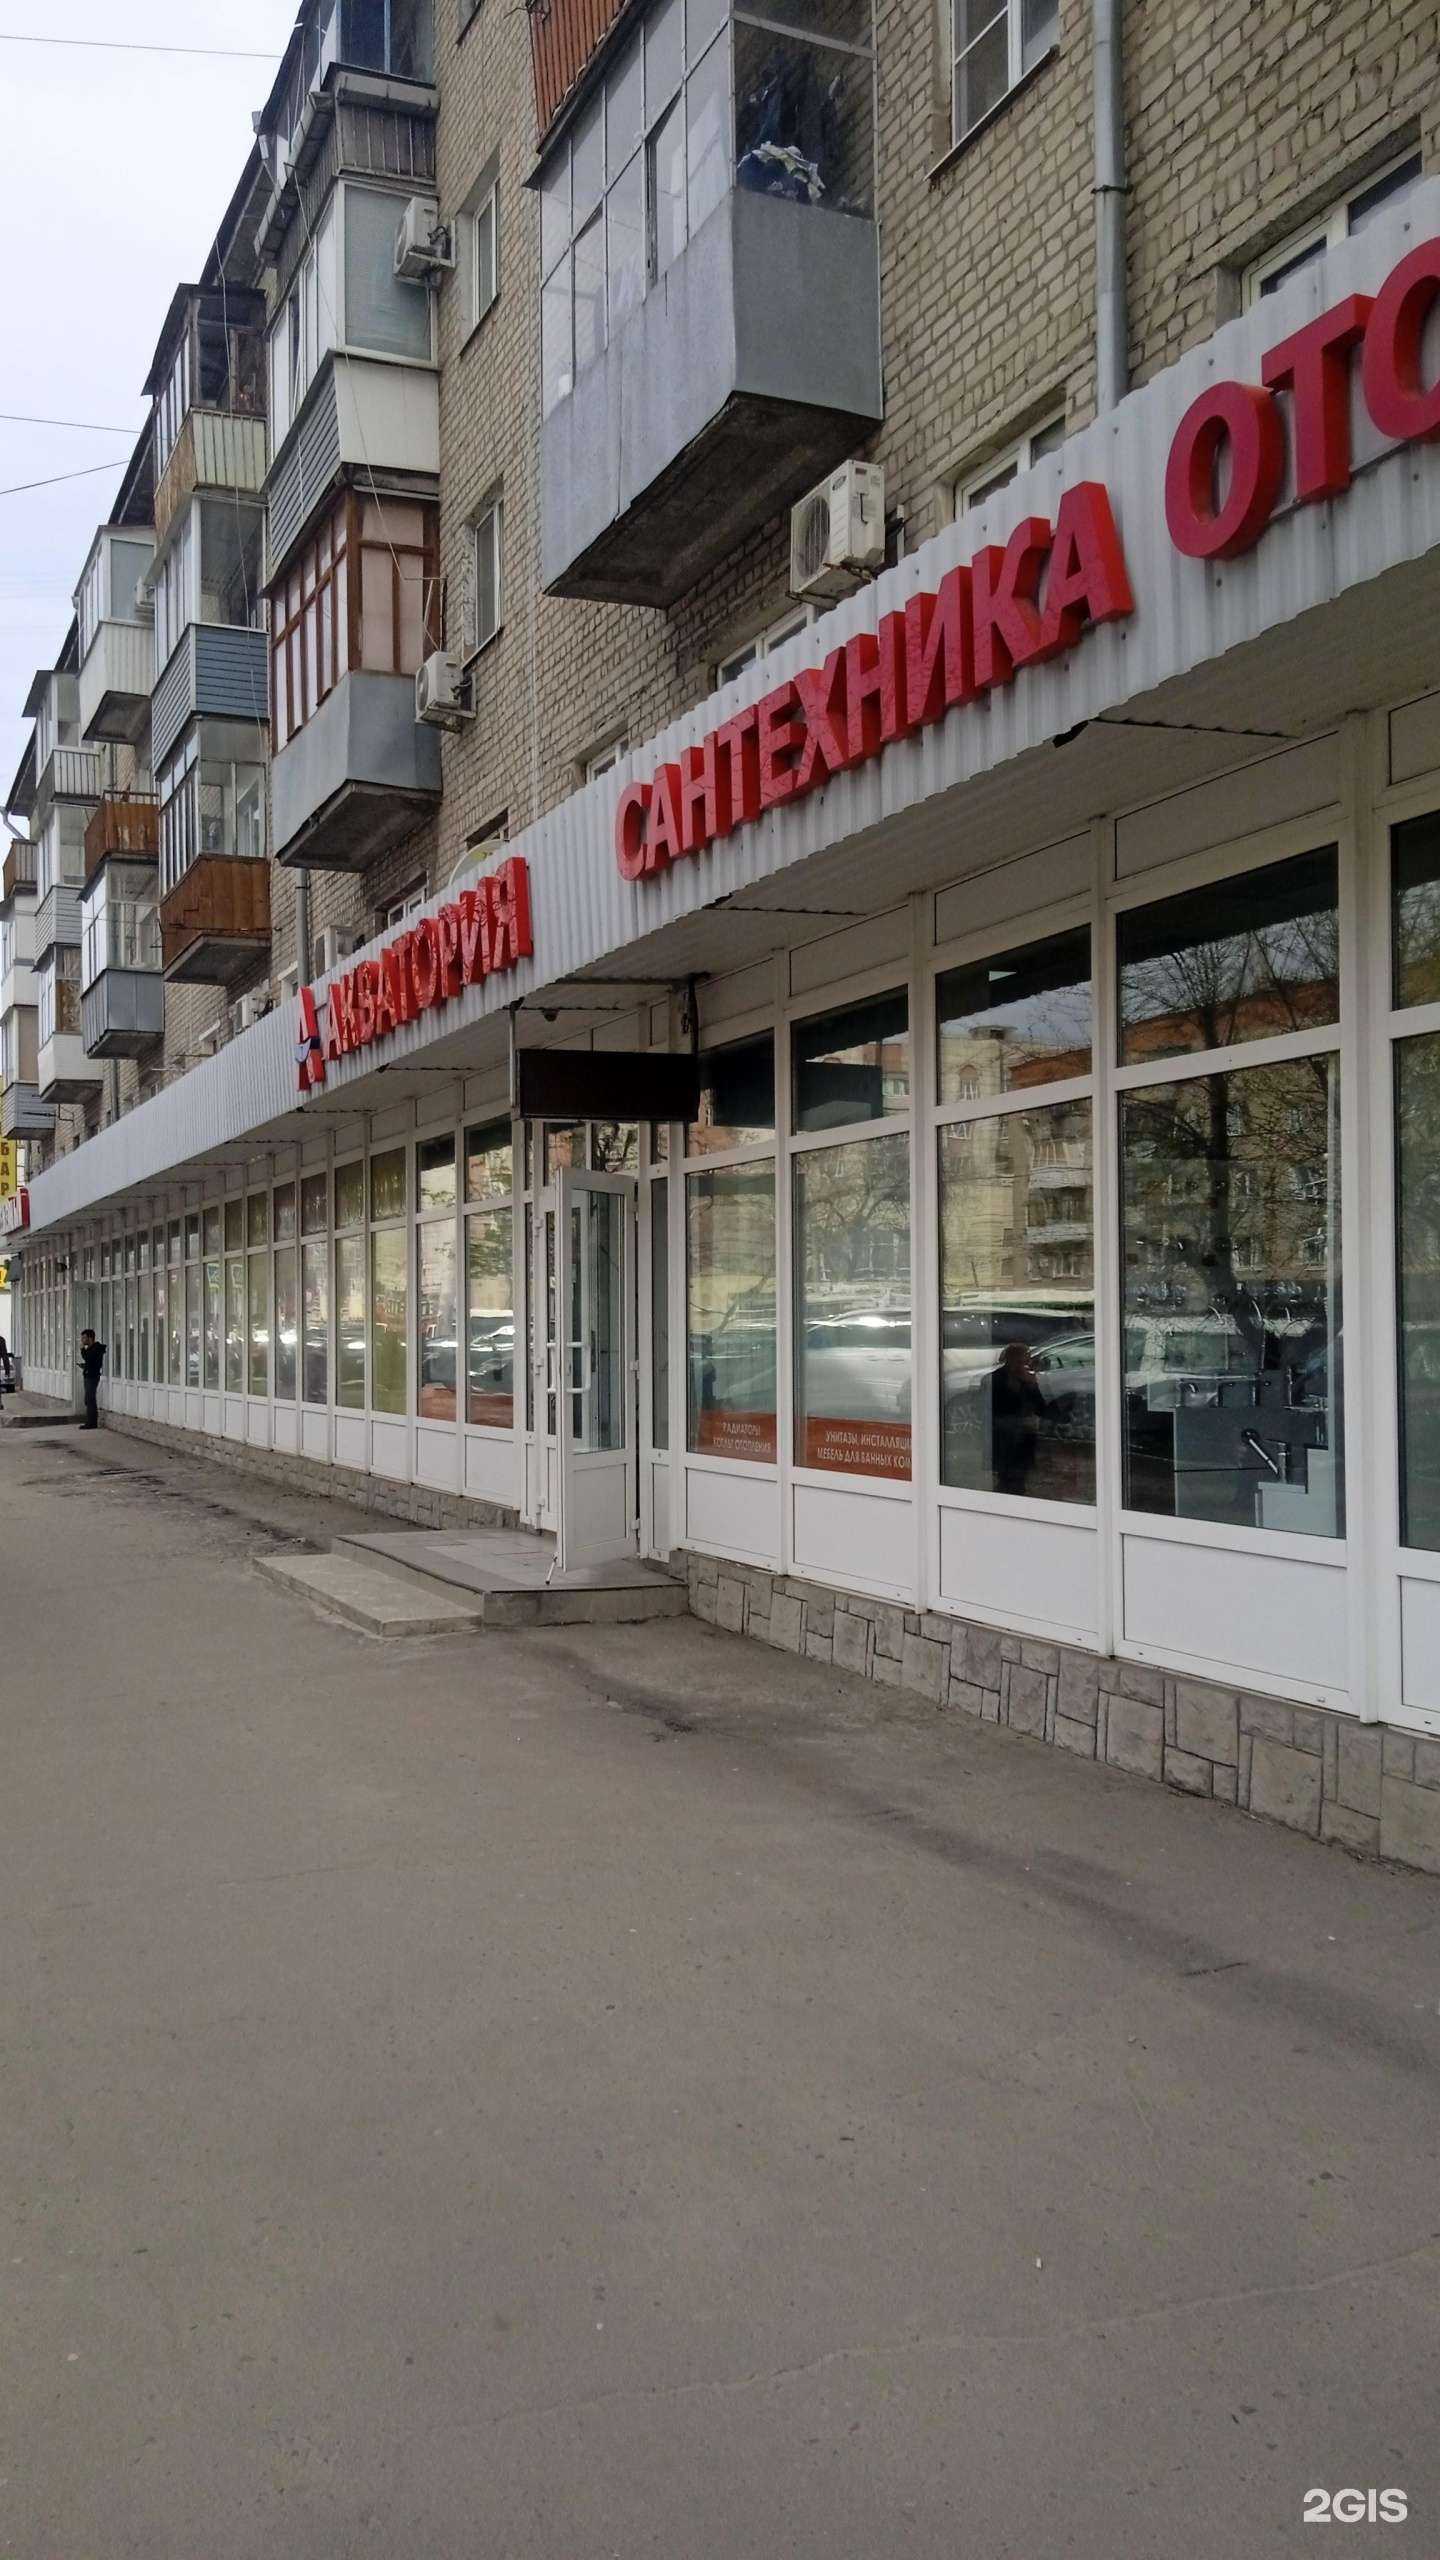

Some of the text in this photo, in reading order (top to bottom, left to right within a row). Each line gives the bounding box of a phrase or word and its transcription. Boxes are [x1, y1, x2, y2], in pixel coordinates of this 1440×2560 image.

[613, 480, 1135, 882] САНТЕХНИКА
[322, 856, 535, 1062] АКВАТОРИЯ
[816, 1447, 843, 1462] МЕБЕЛЬ
[843, 1449, 860, 1464] ДЛЯ
[861, 1451, 892, 1467] ВАННЫХ
